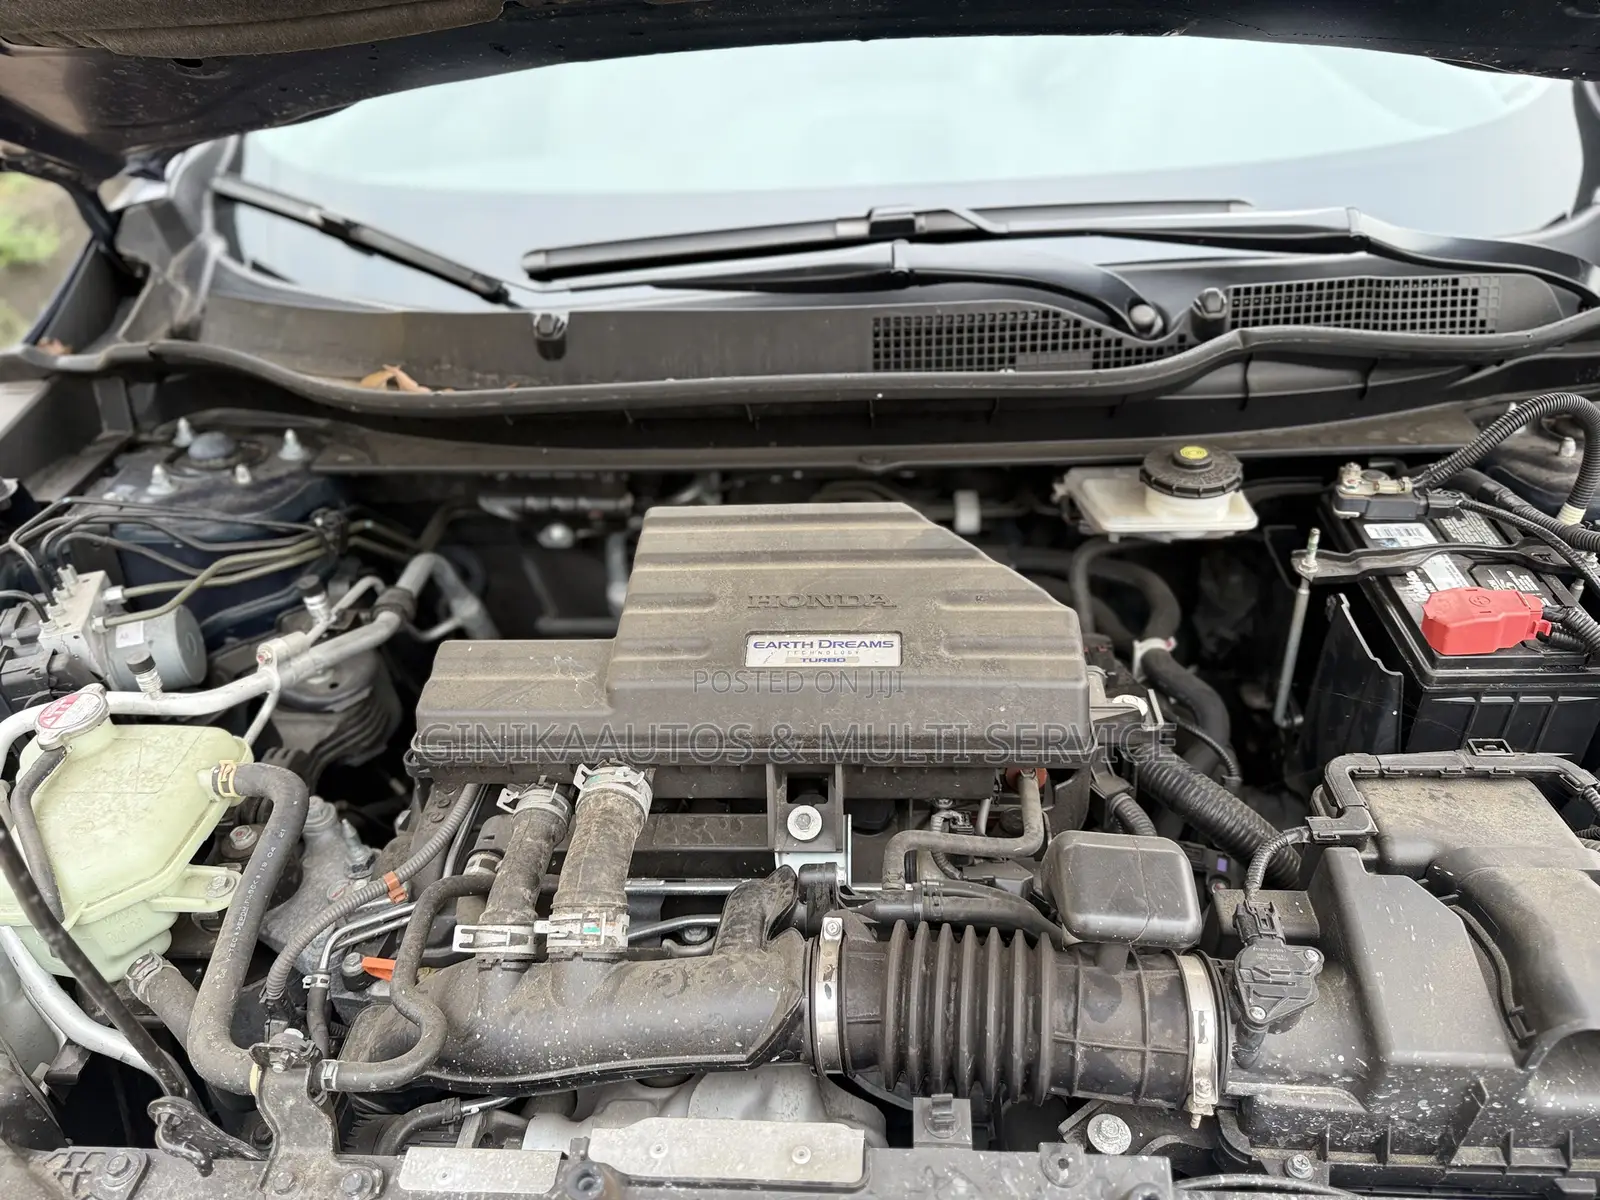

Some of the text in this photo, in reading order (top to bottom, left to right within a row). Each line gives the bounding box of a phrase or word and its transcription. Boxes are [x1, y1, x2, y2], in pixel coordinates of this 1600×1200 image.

[747, 593, 898, 609] HONDA
[753, 639, 895, 650] EARTH DREAMS
